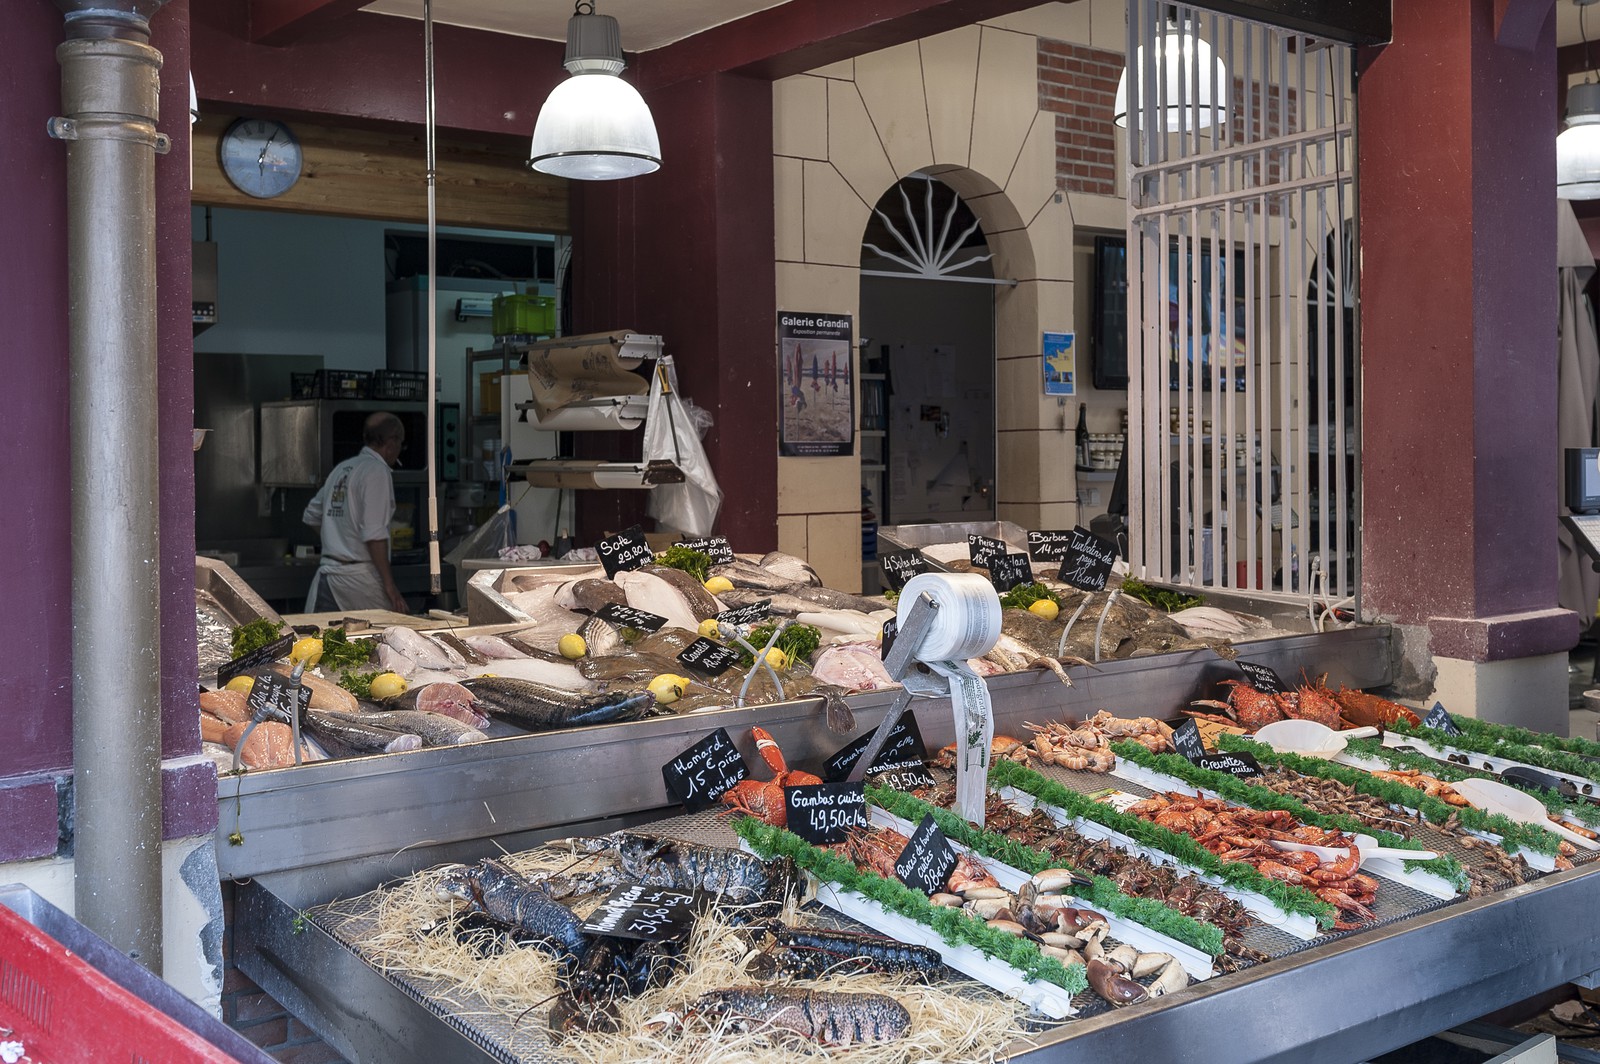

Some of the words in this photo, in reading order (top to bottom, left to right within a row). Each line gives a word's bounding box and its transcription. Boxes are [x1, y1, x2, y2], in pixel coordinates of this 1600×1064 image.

[781, 316, 814, 327] Galerie
[816, 318, 849, 329] Grandin
[792, 328, 816, 336] Exposition
[600, 535, 633, 556] Sole
[710, 537, 727, 547] grise
[1028, 532, 1069, 544] Barbue
[883, 556, 893, 573] 4
[911, 553, 923, 566] de
[1076, 554, 1097, 569] pays
[1101, 550, 1112, 565] de
[715, 602, 761, 621] Rouget
[1200, 755, 1245, 770] Crevettes
[1230, 765, 1255, 774] cuites
[686, 770, 706, 799] 15
[725, 768, 744, 789] ANE
[791, 789, 835, 808] Gambas
[837, 790, 865, 805] cuites
[913, 840, 925, 856] de
[917, 850, 934, 879] cuites
[937, 857, 948, 872] le
[627, 907, 673, 934] 34,50
